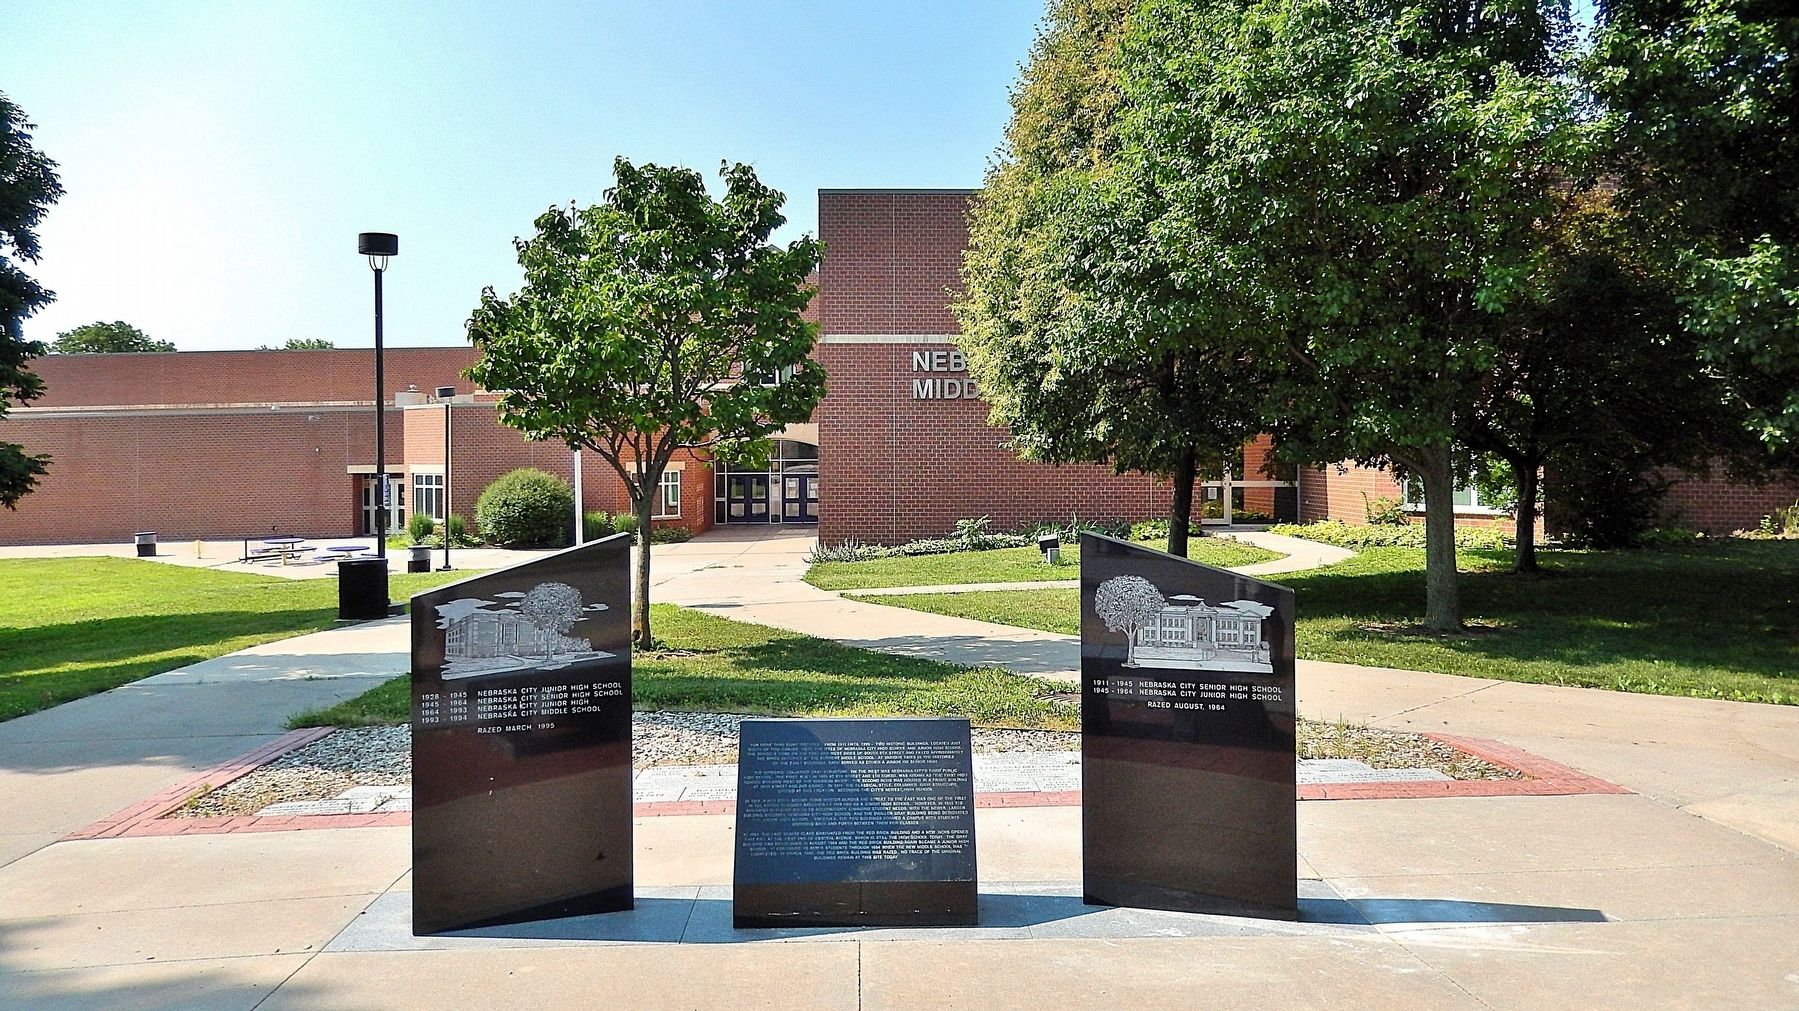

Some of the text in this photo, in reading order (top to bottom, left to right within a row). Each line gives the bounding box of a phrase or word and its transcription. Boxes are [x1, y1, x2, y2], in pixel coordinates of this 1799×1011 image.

[478, 689, 517, 697] NEBRASKA
[478, 696, 517, 704] NEBRASKA
[478, 704, 517, 712] NEBRASKA
[478, 711, 517, 720] NEBRASKA
